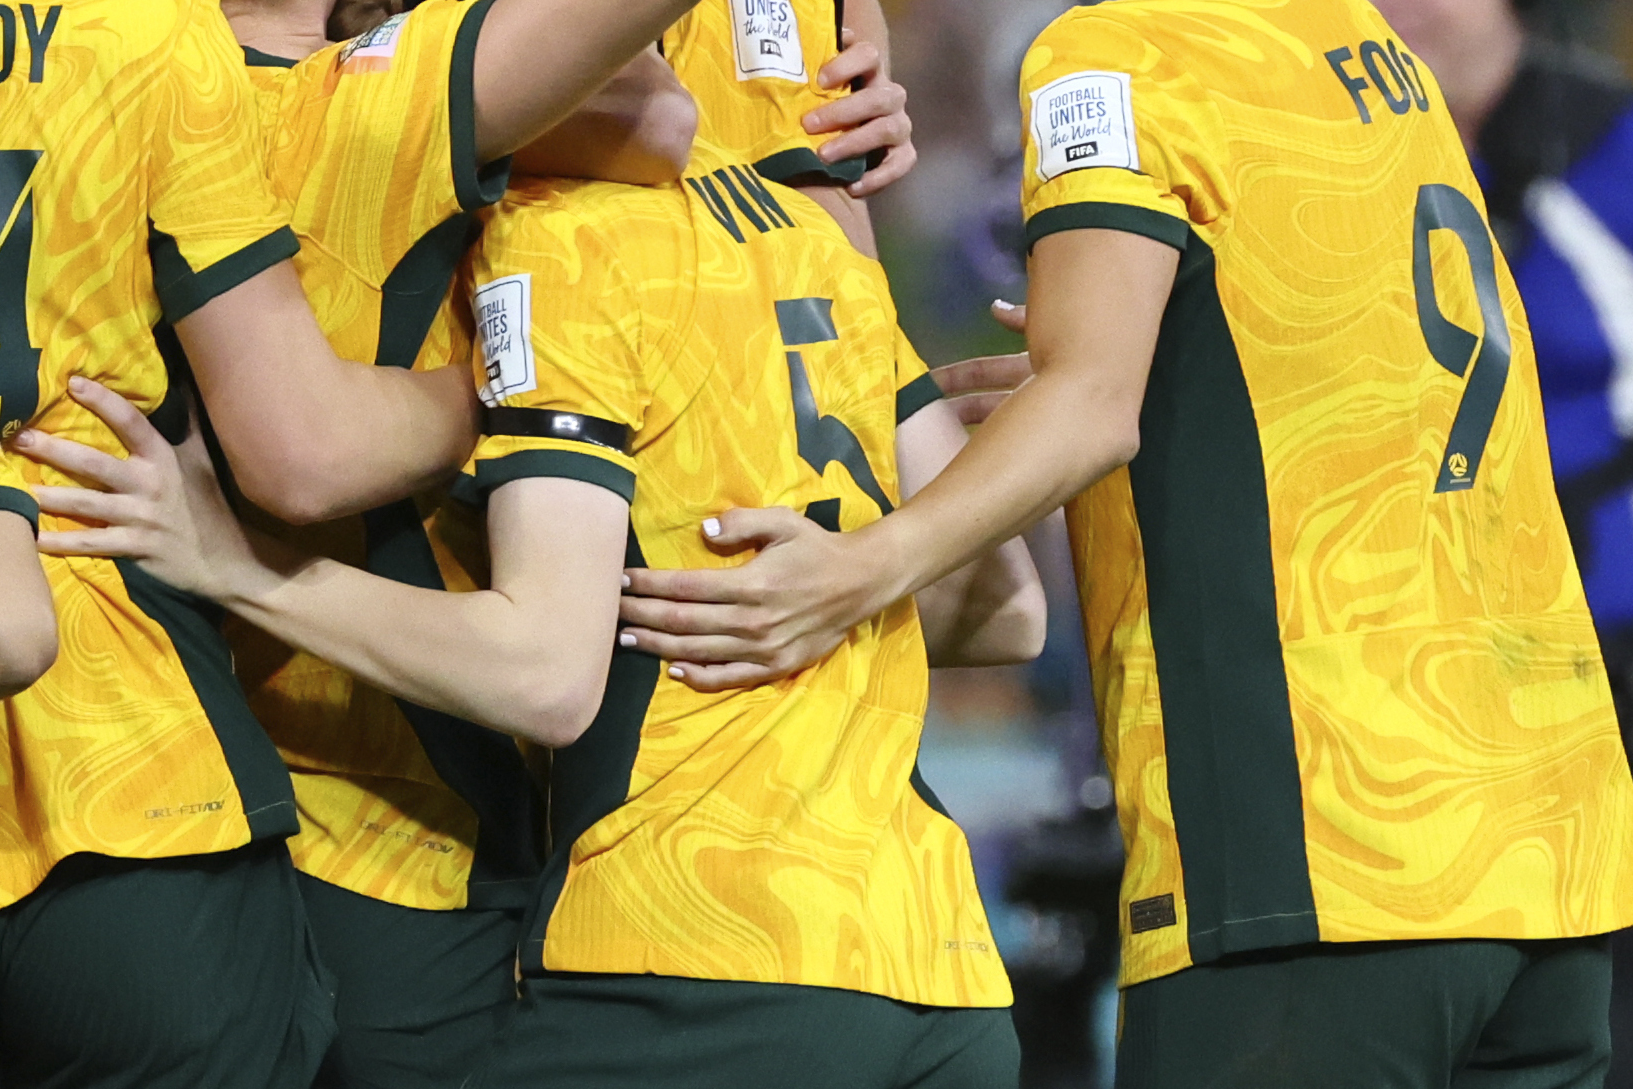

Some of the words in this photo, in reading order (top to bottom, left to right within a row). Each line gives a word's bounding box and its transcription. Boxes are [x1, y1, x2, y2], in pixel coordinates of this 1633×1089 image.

[1049, 85, 1105, 111] FOOTBALL
[1049, 101, 1107, 130] UNITES
[1049, 129, 1070, 149] the
[1071, 117, 1112, 141] World
[1068, 144, 1096, 159] FIFA
[1412, 182, 1512, 495] 9
[773, 296, 896, 533] 5
